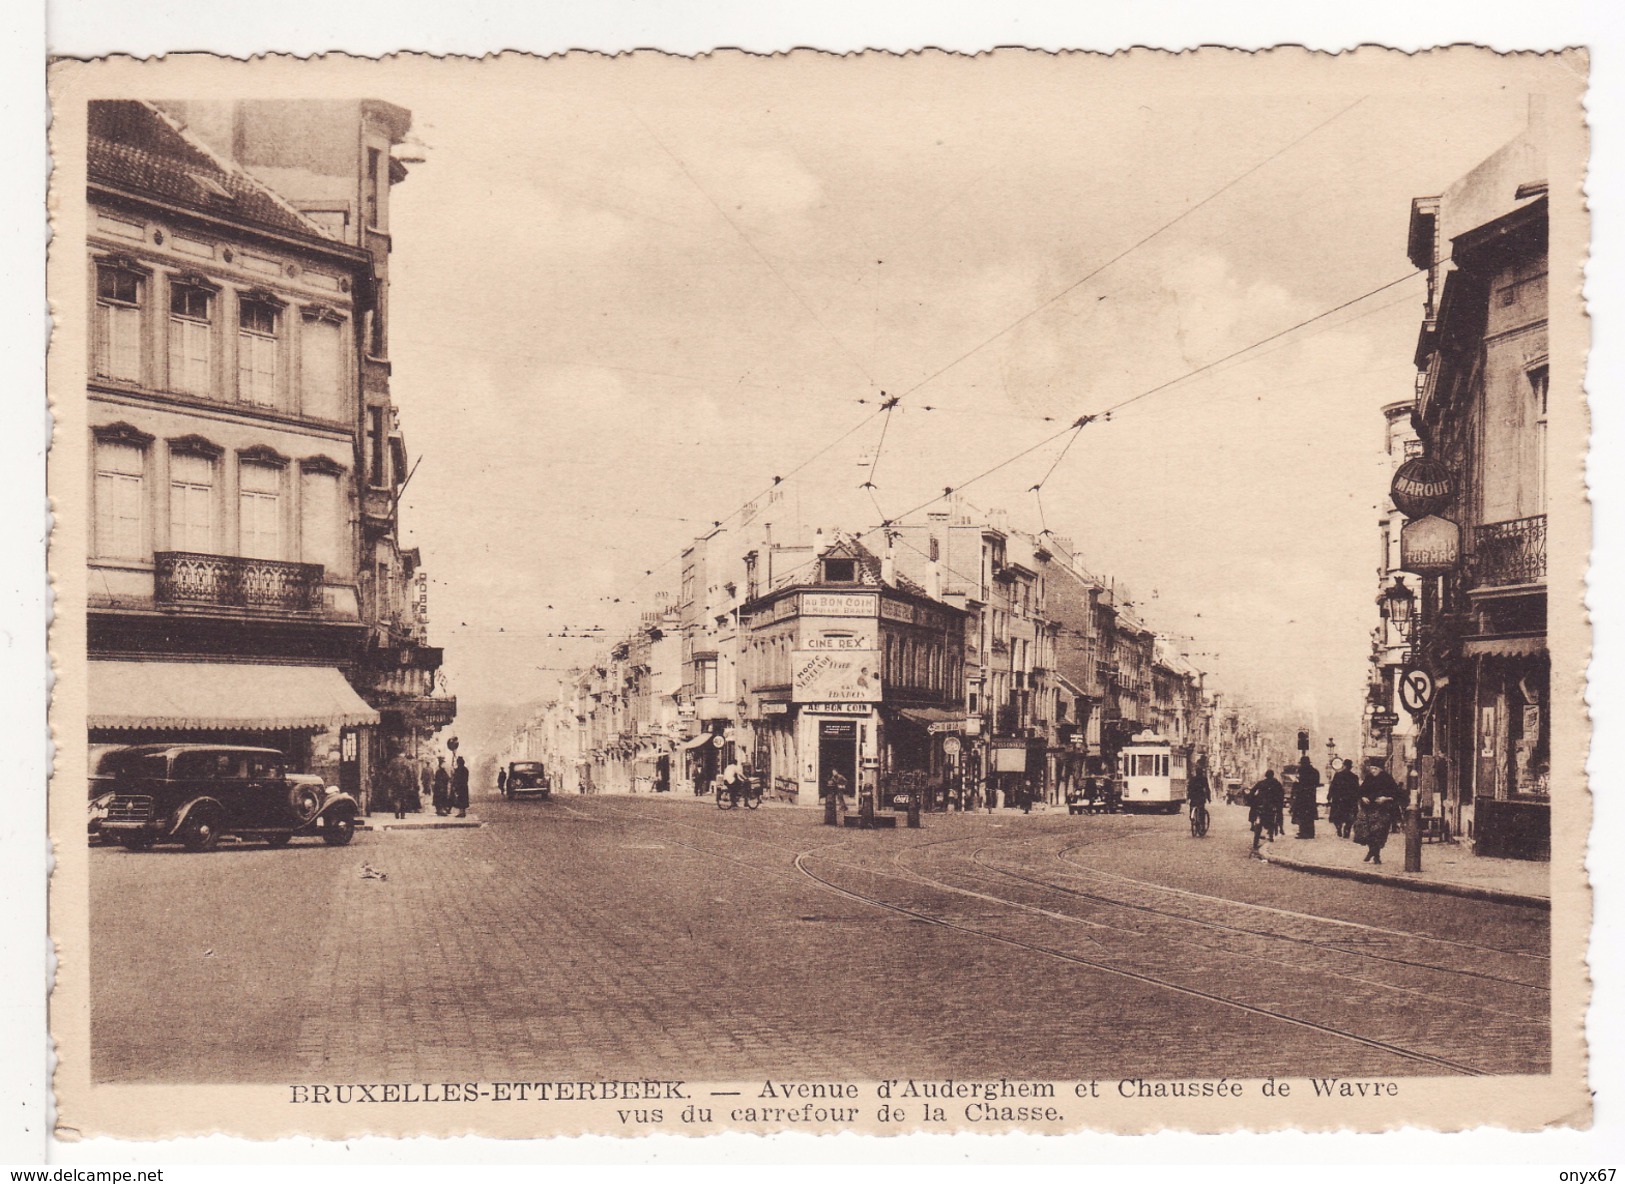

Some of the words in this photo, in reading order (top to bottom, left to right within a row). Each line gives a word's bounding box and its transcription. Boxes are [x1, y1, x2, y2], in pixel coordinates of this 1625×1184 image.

[1394, 476, 1450, 497] MAROUF
[820, 597, 843, 607] BON
[845, 598, 873, 607] COIN
[808, 639, 833, 649] CINE
[839, 639, 862, 649] REX
[1413, 676, 1427, 704] P
[808, 703, 819, 711] AU
[824, 703, 843, 712] BON
[846, 704, 868, 712] COIN
